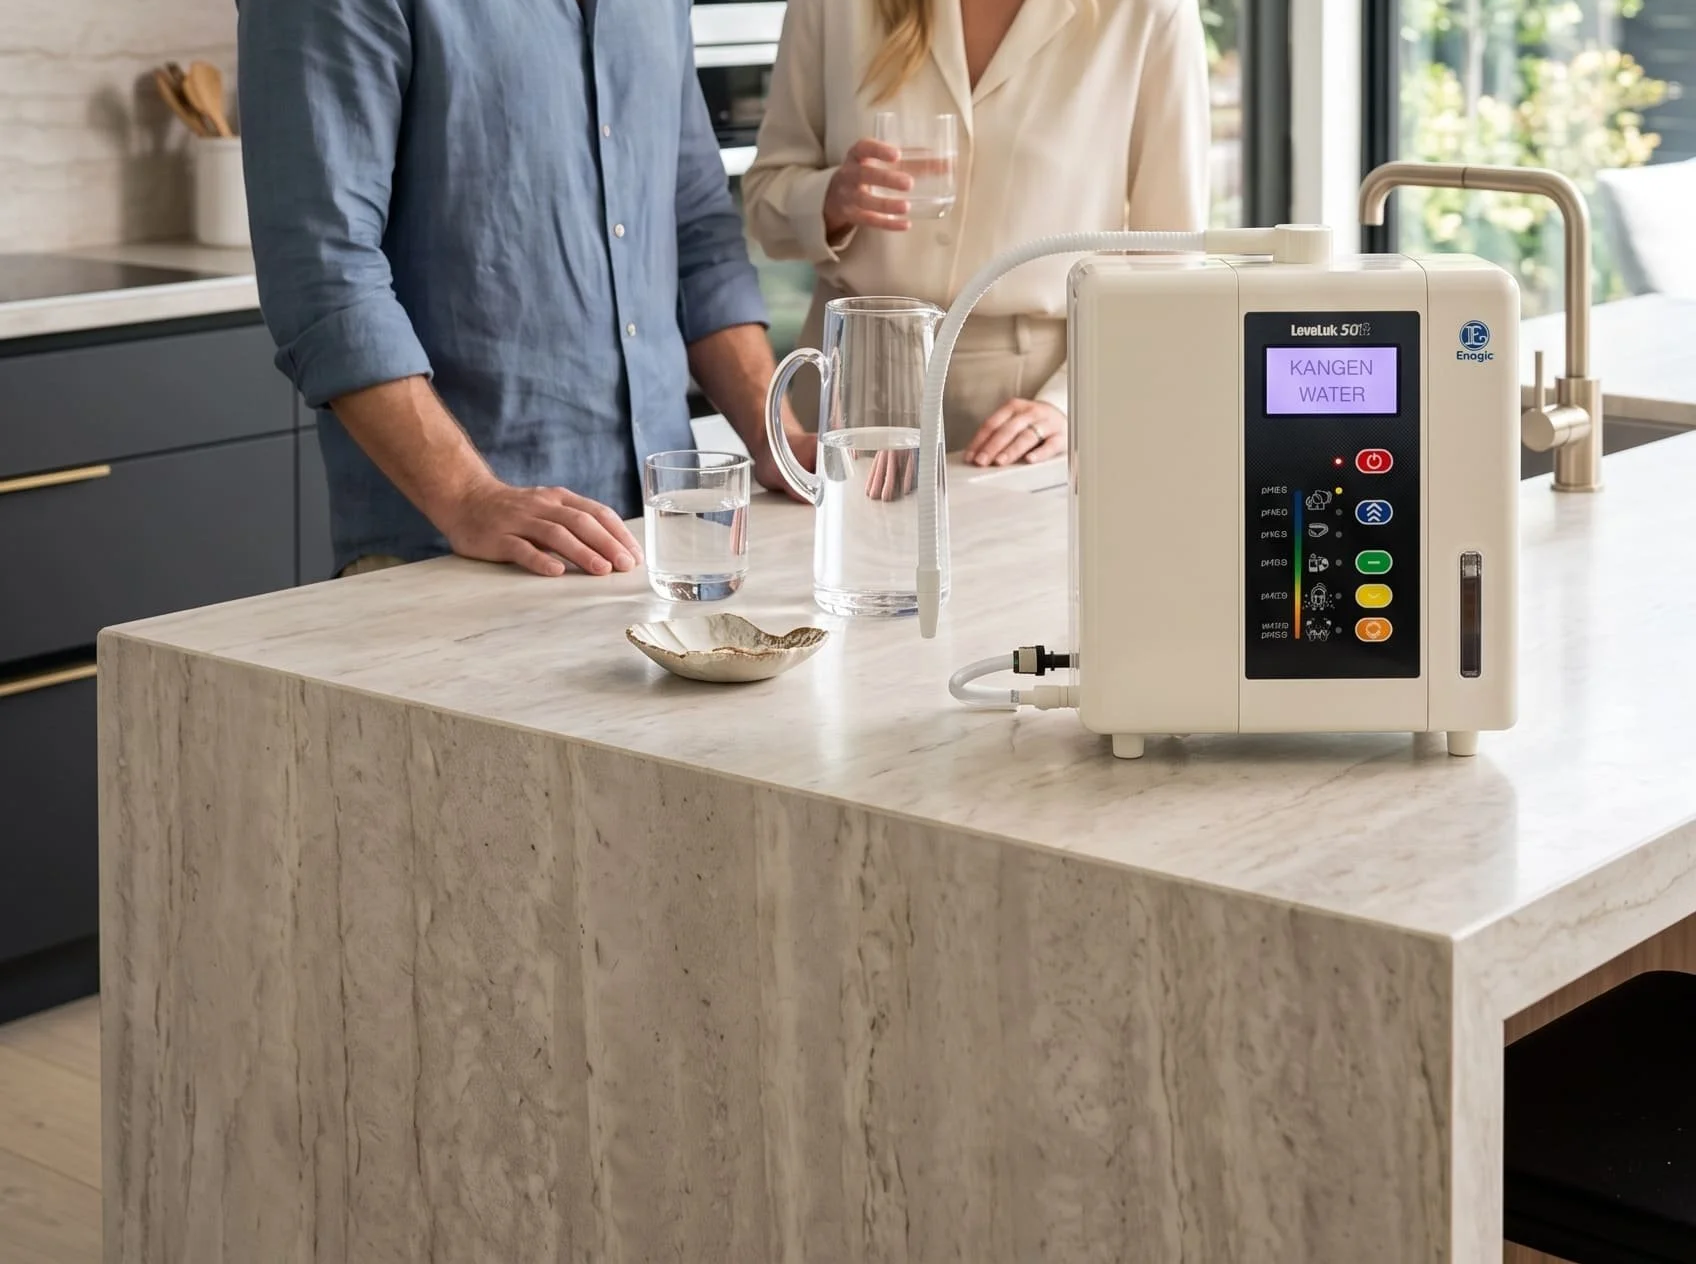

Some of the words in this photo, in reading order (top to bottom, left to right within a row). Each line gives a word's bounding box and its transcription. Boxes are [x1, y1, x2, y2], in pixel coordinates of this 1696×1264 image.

[1456, 350, 1494, 363] Enagic
[1290, 359, 1373, 376] KANGEN
[1299, 386, 1365, 402] WATER
